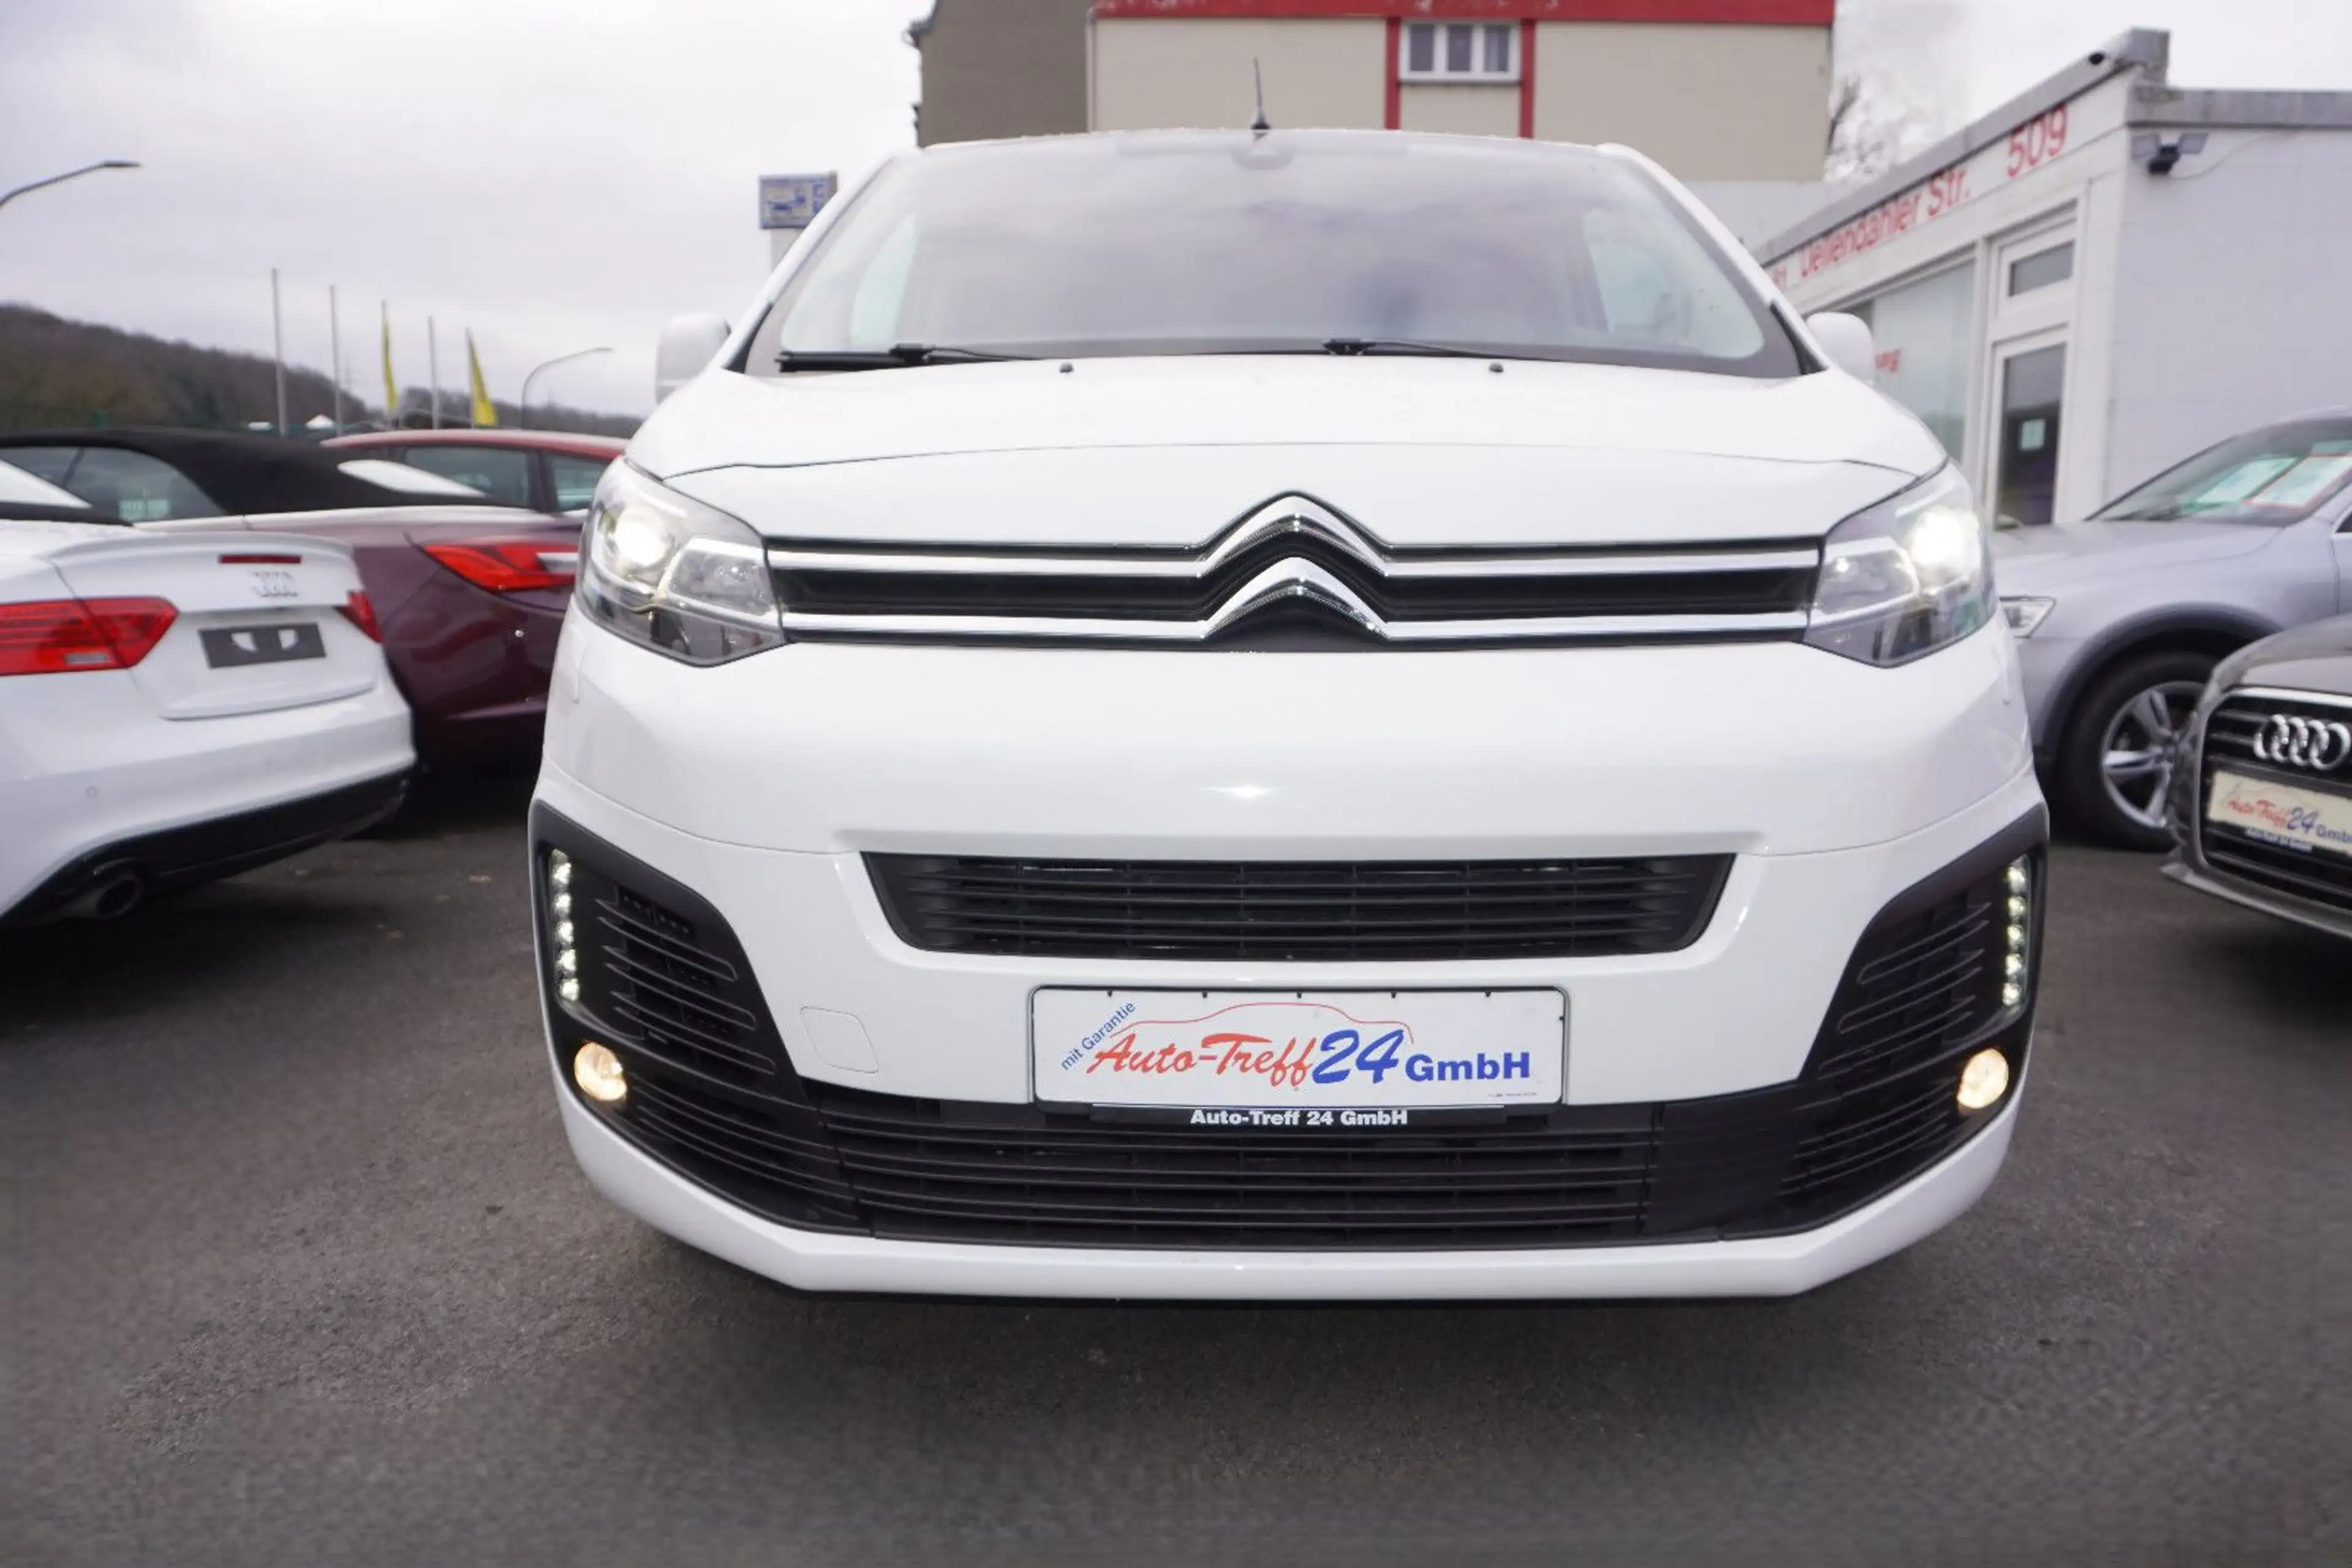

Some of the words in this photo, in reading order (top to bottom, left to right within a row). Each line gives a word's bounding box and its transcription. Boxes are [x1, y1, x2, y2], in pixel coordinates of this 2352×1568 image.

[1928, 168, 1972, 219] Str.
[2007, 103, 2068, 178] 509
[2287, 806, 2320, 834] 24
[1061, 1047, 1083, 1071] mit
[1081, 1001, 1135, 1051] Garantie
[1085, 1033, 1317, 1087] Auto-Treff
[1311, 1028, 1404, 1084] 24
[1405, 1052, 1530, 1082] GmbH
[1190, 1109, 1300, 1126] Auto-Treff
[1306, 1110, 1334, 1126] 24
[1340, 1110, 1409, 1126] GmbH
